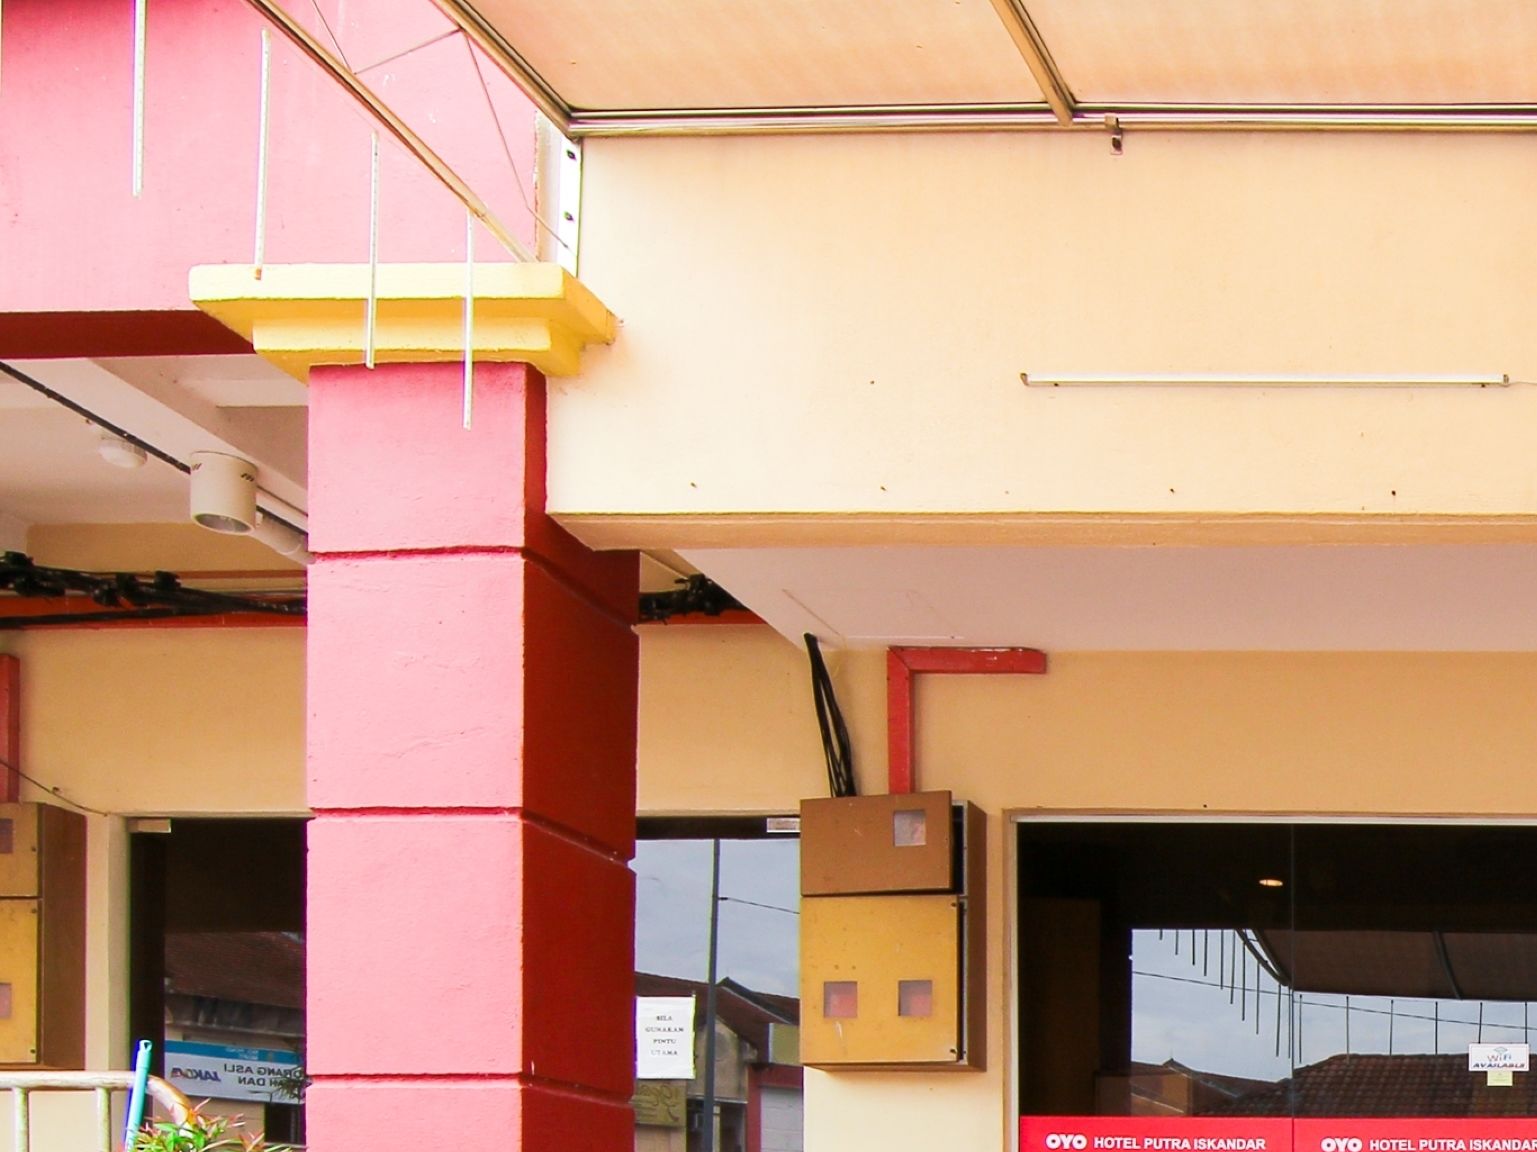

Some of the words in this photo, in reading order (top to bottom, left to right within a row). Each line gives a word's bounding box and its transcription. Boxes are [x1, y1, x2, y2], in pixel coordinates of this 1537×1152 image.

[1045, 1133, 1088, 1150] OYO
[1094, 1136, 1141, 1150] HOTEL
[1144, 1137, 1192, 1151] PUTRA
[1194, 1138, 1266, 1151] ISKANDAR
[1320, 1137, 1363, 1152] OYO
[1369, 1139, 1417, 1152] HOTEL
[1419, 1139, 1467, 1152] PUTRA
